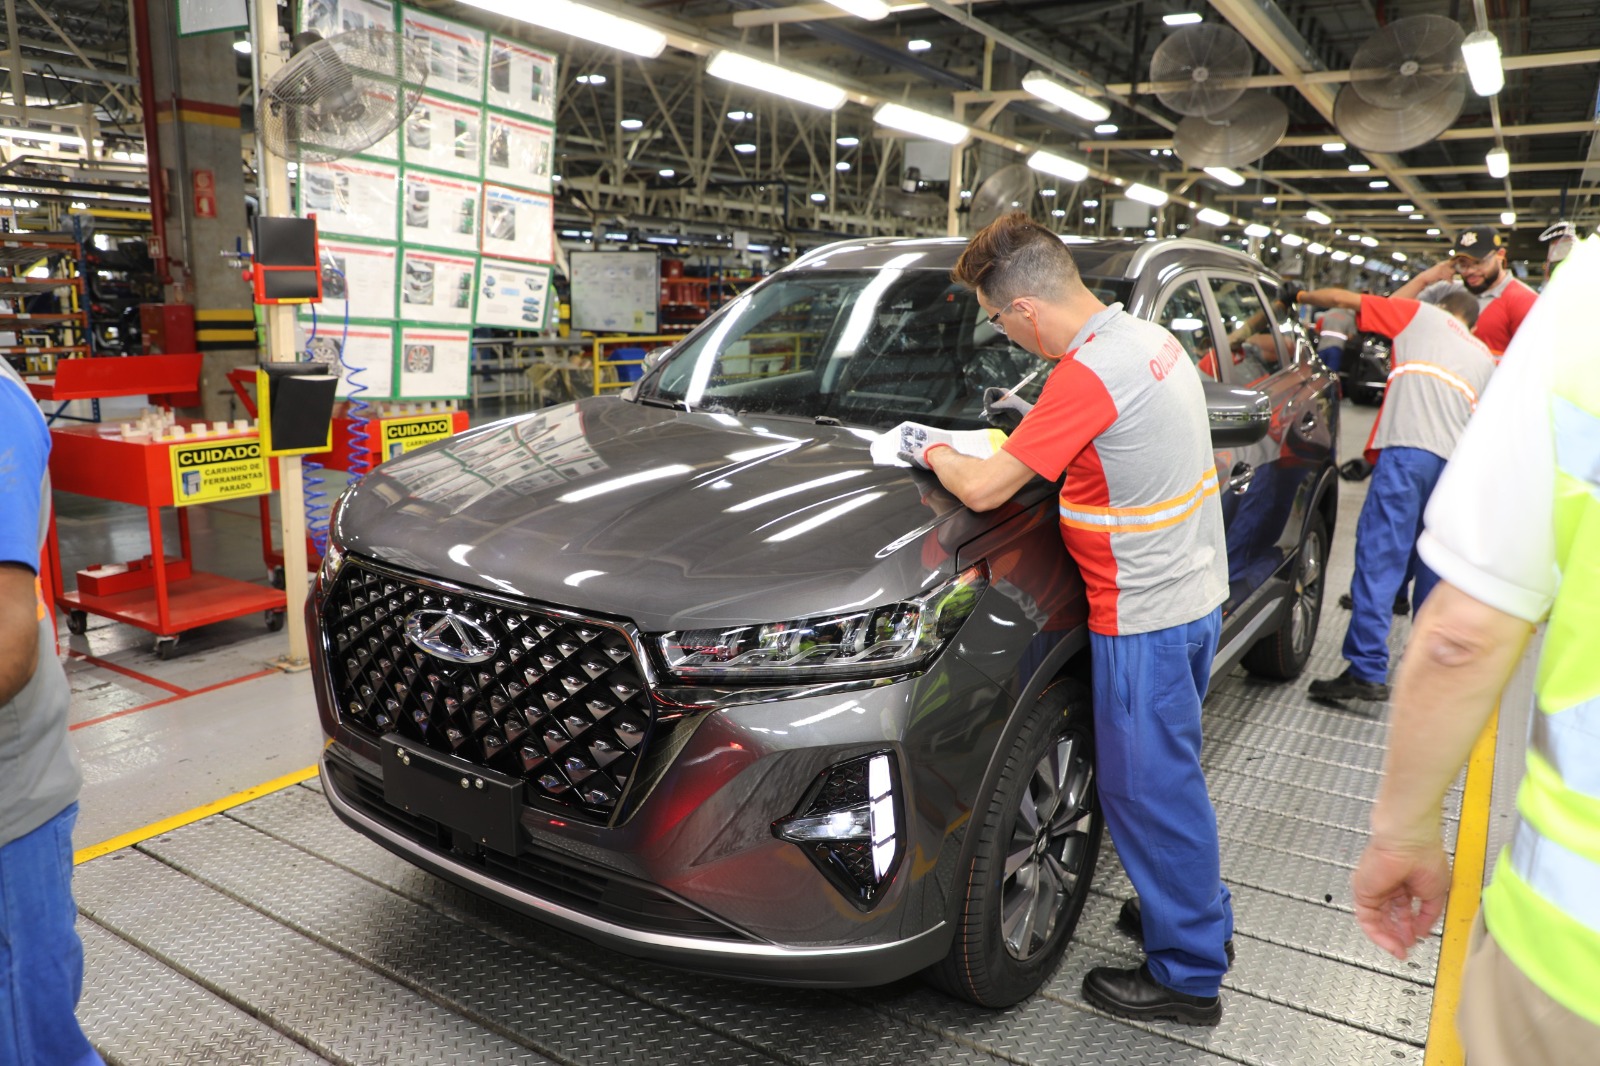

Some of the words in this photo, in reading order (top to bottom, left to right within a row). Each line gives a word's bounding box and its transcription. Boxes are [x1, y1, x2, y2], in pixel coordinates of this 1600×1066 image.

[388, 421, 448, 438] CUIDADO
[179, 445, 260, 465] CUIDADO
[204, 464, 248, 476] CARRINHO
[203, 472, 263, 485] FERRAMENTAS
[219, 482, 252, 493] PARADO
